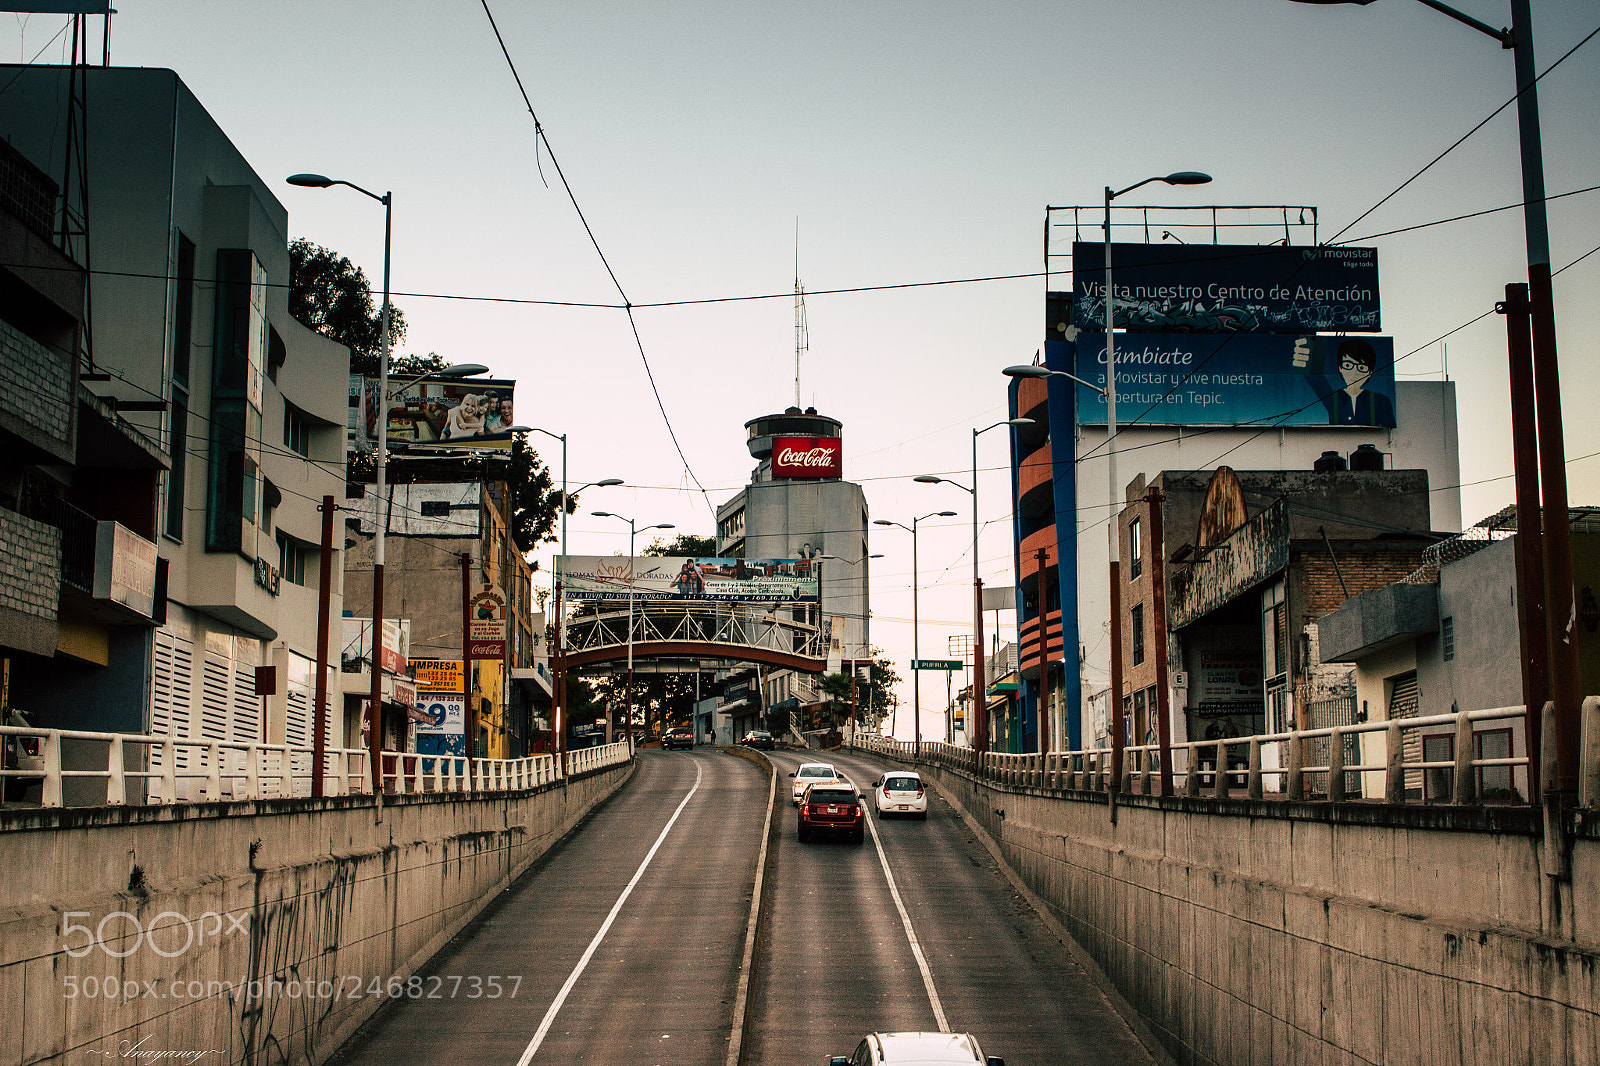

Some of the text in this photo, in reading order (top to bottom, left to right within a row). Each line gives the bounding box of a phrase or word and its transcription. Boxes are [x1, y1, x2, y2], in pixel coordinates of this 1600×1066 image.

[1324, 249, 1373, 259] movistar
[1081, 281, 1372, 301] Vista nuestro Centro de Atención
[1097, 374, 1106, 384] a
[1171, 374, 1179, 388] y
[1184, 374, 1209, 385] vive
[1212, 373, 1264, 386] nuestra
[1166, 393, 1183, 404] en
[1187, 391, 1225, 407] Tepic.
[413, 660, 458, 671] IMPRESA
[1176, 675, 1183, 683] E
